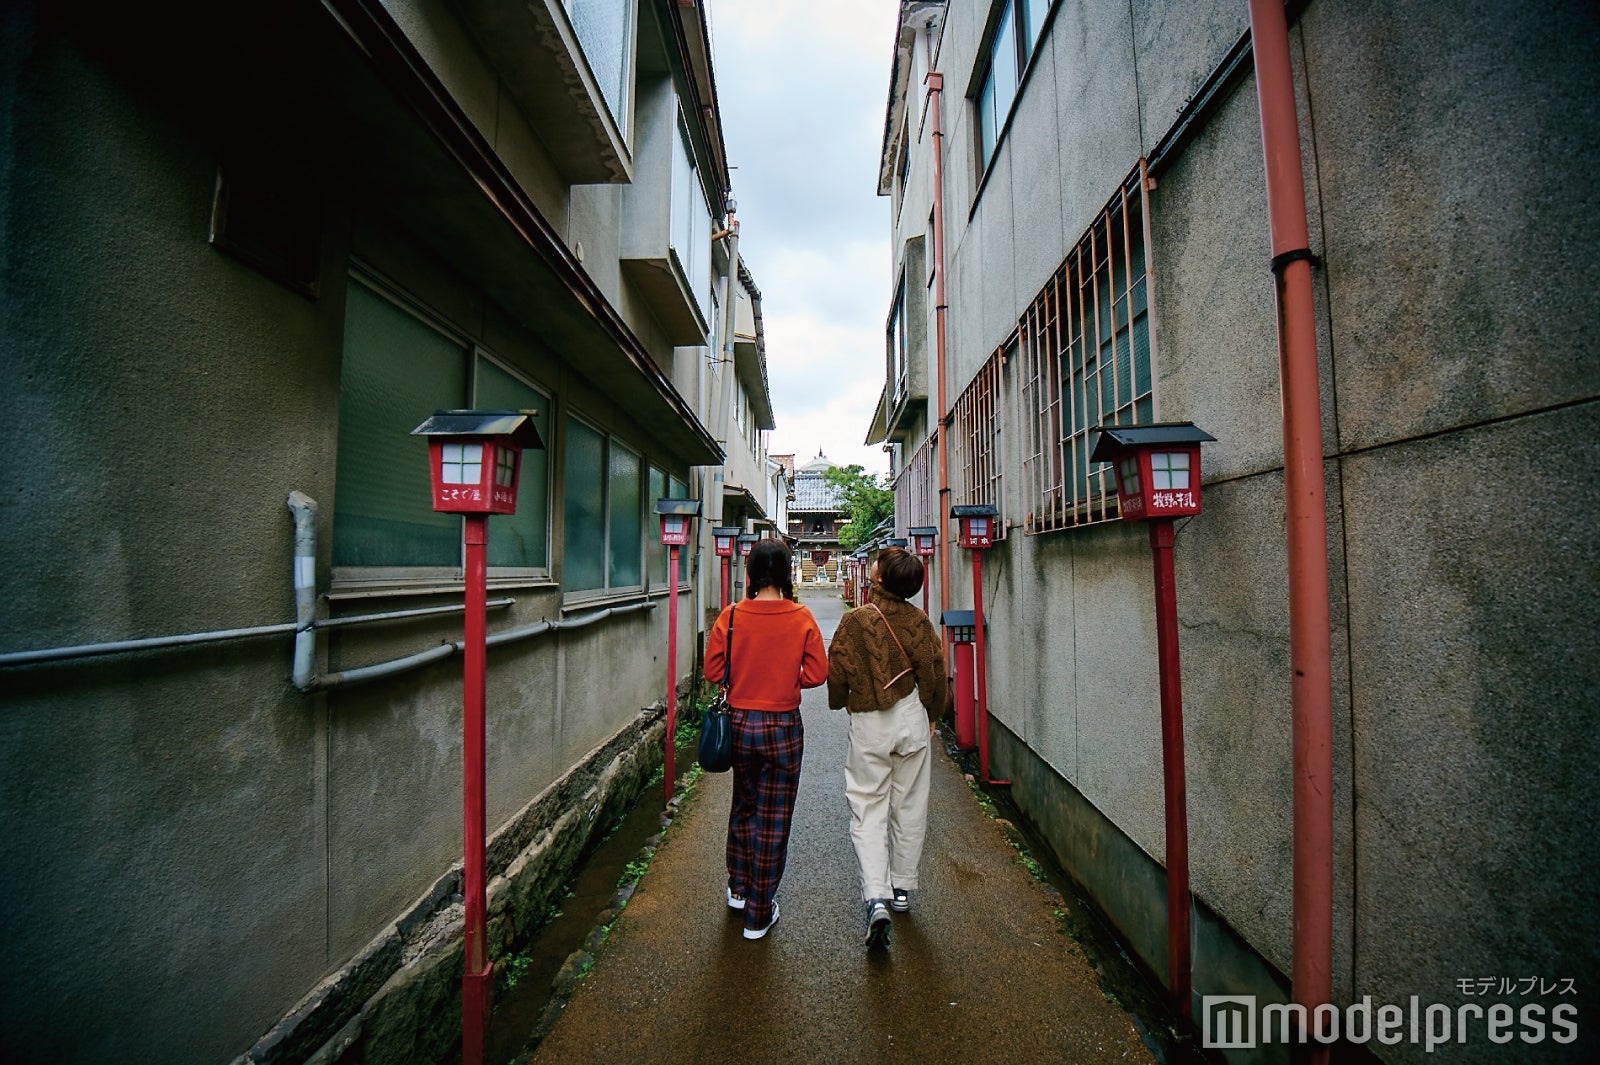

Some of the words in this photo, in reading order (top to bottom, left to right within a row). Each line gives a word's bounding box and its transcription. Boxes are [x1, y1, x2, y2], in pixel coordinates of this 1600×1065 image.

[1152, 492, 1197, 508] 牧野の牛乳
